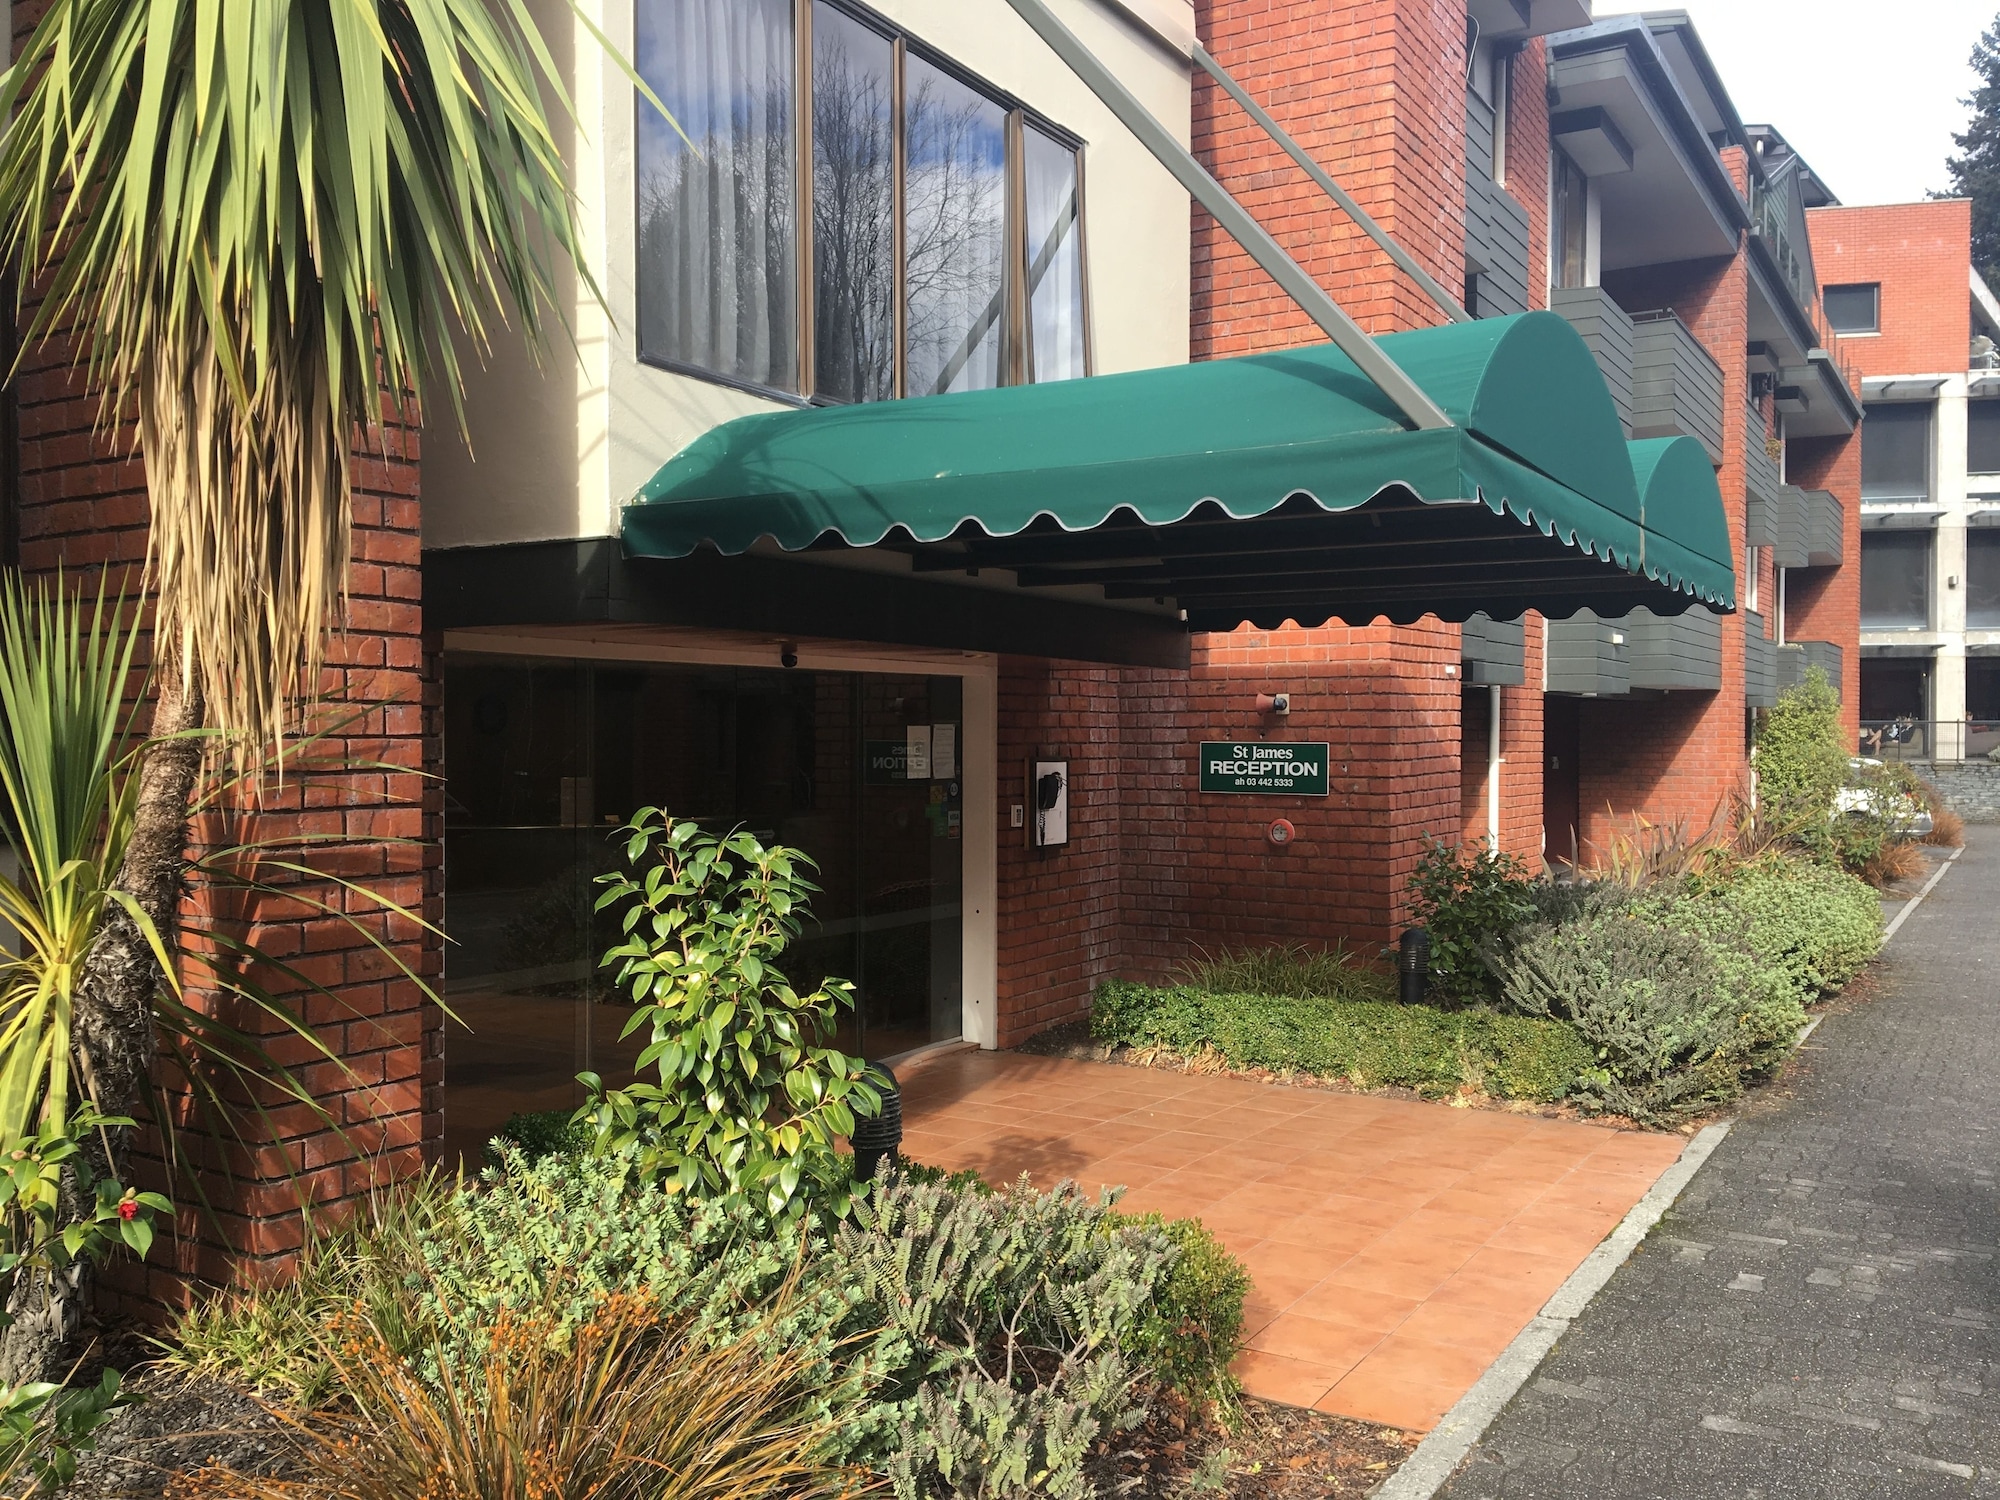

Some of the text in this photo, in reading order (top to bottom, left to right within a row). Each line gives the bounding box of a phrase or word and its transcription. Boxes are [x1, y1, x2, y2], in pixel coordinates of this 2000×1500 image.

[1233, 745, 1293, 760] St James
[1210, 760, 1318, 776] RECEPTION
[1235, 777, 1293, 787] ah 03 442 5333
